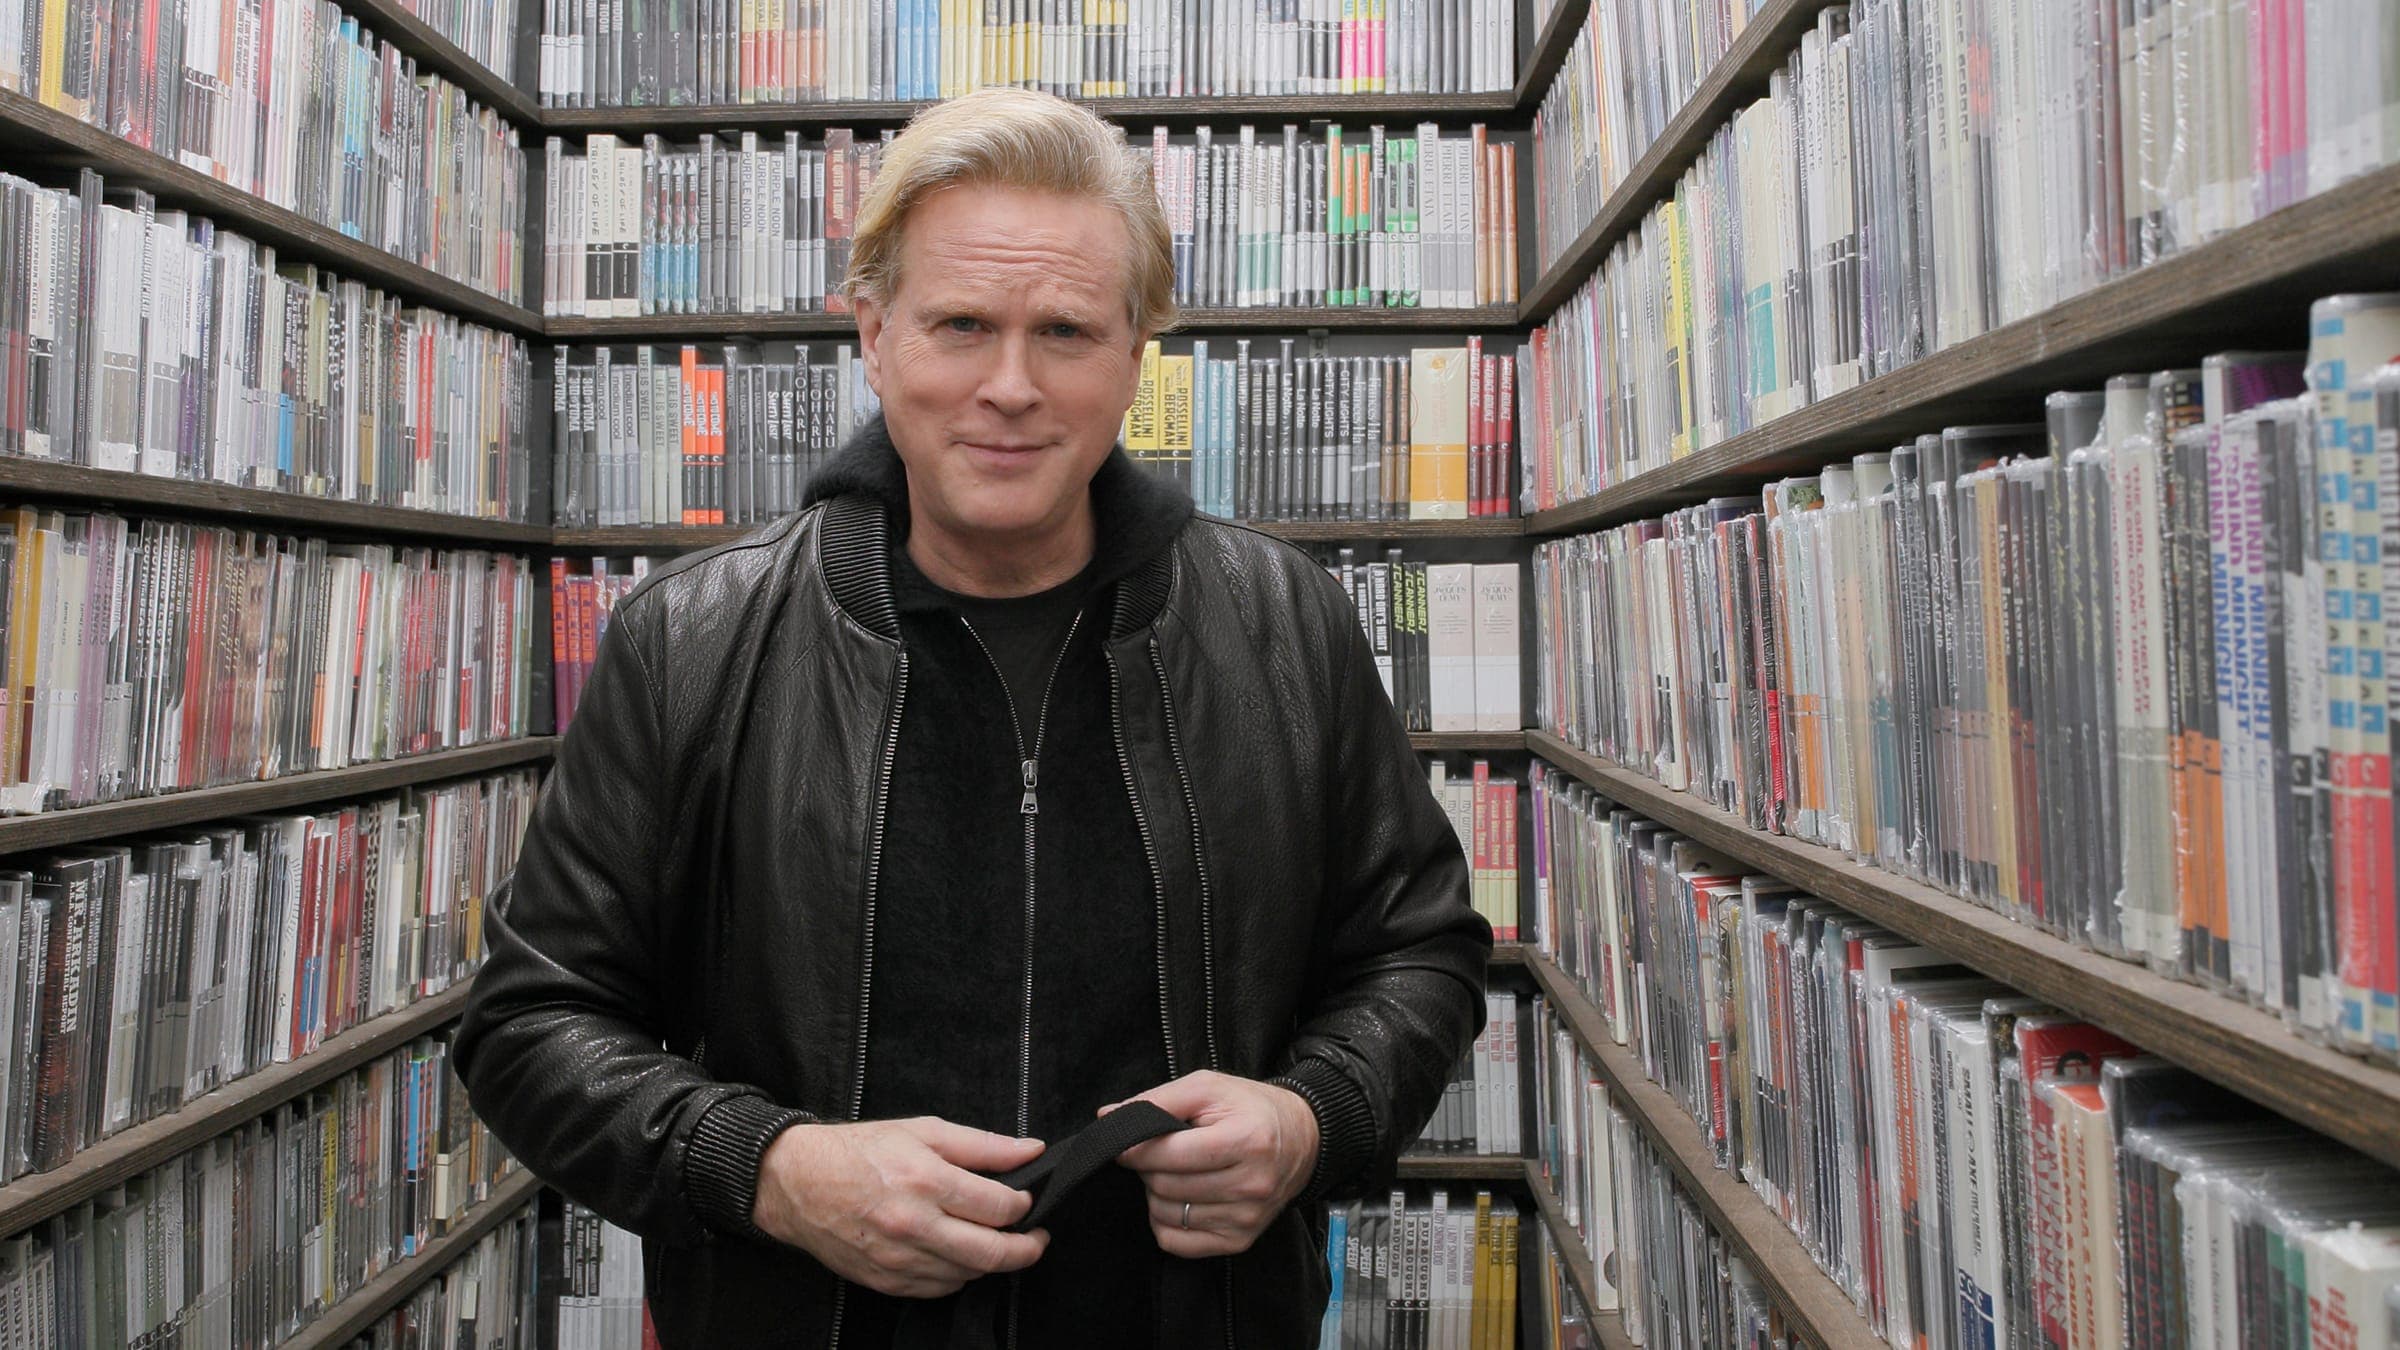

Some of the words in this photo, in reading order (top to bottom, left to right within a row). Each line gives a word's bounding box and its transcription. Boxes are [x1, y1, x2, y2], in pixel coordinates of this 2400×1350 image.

[591, 144, 600, 188] TRILOGY
[832, 149, 845, 163] THE
[1423, 131, 1435, 169] PIERRE
[1442, 145, 1453, 185] PIERRE
[1459, 145, 1470, 185] PIERRE
[742, 151, 753, 194] PURPLE
[756, 156, 767, 198] PURPLE
[771, 160, 781, 203] PURPLE
[591, 194, 600, 206] OF
[742, 199, 753, 229] NOON
[756, 203, 767, 233] NOON
[591, 210, 600, 236] LIFE
[771, 208, 781, 237] NOON
[598, 356, 608, 397] medium
[640, 353, 649, 372] LIFE
[640, 376, 649, 385] IS
[1283, 373, 1292, 386] La
[613, 375, 622, 414] medium
[625, 373, 635, 414] medium
[655, 379, 665, 397] LIFE
[669, 376, 679, 395] LIFE
[1297, 388, 1306, 400] La
[1312, 388, 1320, 400] La
[1324, 371, 1334, 396] CITY
[1340, 370, 1349, 395] CITY
[598, 399, 608, 420] cool
[640, 390, 649, 422] SWEET
[655, 401, 665, 410] IS
[669, 399, 679, 408] IS
[768, 391, 779, 419] SAFETY
[781, 391, 793, 419] SAFETY
[795, 377, 807, 443] OHARU
[810, 389, 822, 448] OHARU
[824, 388, 836, 448] OHARU
[1142, 380, 1154, 438] ROSSELLINI
[1165, 394, 1175, 446] BERGMAN
[1176, 388, 1188, 446] ROSSELLINI
[1283, 387, 1292, 416] Notte
[1297, 401, 1306, 428] Notte
[1312, 401, 1320, 428] Notte
[1324, 401, 1334, 438] LIGHTS
[1340, 400, 1349, 437] LIGHTS
[613, 416, 622, 440] cool
[625, 416, 635, 438] cool
[655, 415, 665, 447] SWEET
[669, 412, 679, 444] SWEET
[1352, 426, 1366, 444] Ha
[1367, 422, 1380, 440] Ha
[2133, 466, 2141, 503] THE
[2126, 517, 2134, 562] GIRL
[2135, 511, 2143, 557] GIRL
[141, 536, 150, 585] YOUTH
[150, 537, 158, 585] YOUTH
[1357, 589, 1367, 607] HARD
[1373, 576, 1387, 599] HARD
[1393, 563, 1403, 632] SCANNERS
[1405, 570, 1415, 635] SCANNERS
[1416, 570, 1426, 634] SCANNERS
[2128, 569, 2138, 632] CAN'T
[2137, 563, 2146, 625] CAN'T
[138, 598, 146, 645] BEAST
[156, 603, 164, 646] ELEGY
[1373, 626, 1387, 652] NIGHT
[2212, 551, 2232, 708] MIDNIGHT
[2132, 640, 2141, 694] HELP
[2140, 635, 2149, 689] HELP
[2232, 576, 2250, 733] MIDNIGHT
[2250, 585, 2271, 743] MIDNIGHT
[2134, 696, 2142, 714] IT
[2142, 695, 2151, 711] IT
[72, 879, 85, 923] MR.
[62, 916, 73, 991] CONFIDENTIAL
[65, 927, 82, 1032] ARKADIN
[1433, 1208, 1444, 1224] LADY
[1446, 1225, 1457, 1243] LADY
[1347, 1236, 1358, 1270] SPEEDY
[1391, 1201, 1401, 1278] BURROUGHS
[1433, 1226, 1444, 1265] SNOWBLOOD
[1360, 1246, 1371, 1279] SPEEDY
[1375, 1245, 1386, 1278] SPEEDY
[1405, 1221, 1414, 1298] BURROUGHS
[1420, 1221, 1429, 1298] BURROUGHS
[1446, 1245, 1457, 1285] SNOWBLOOD
